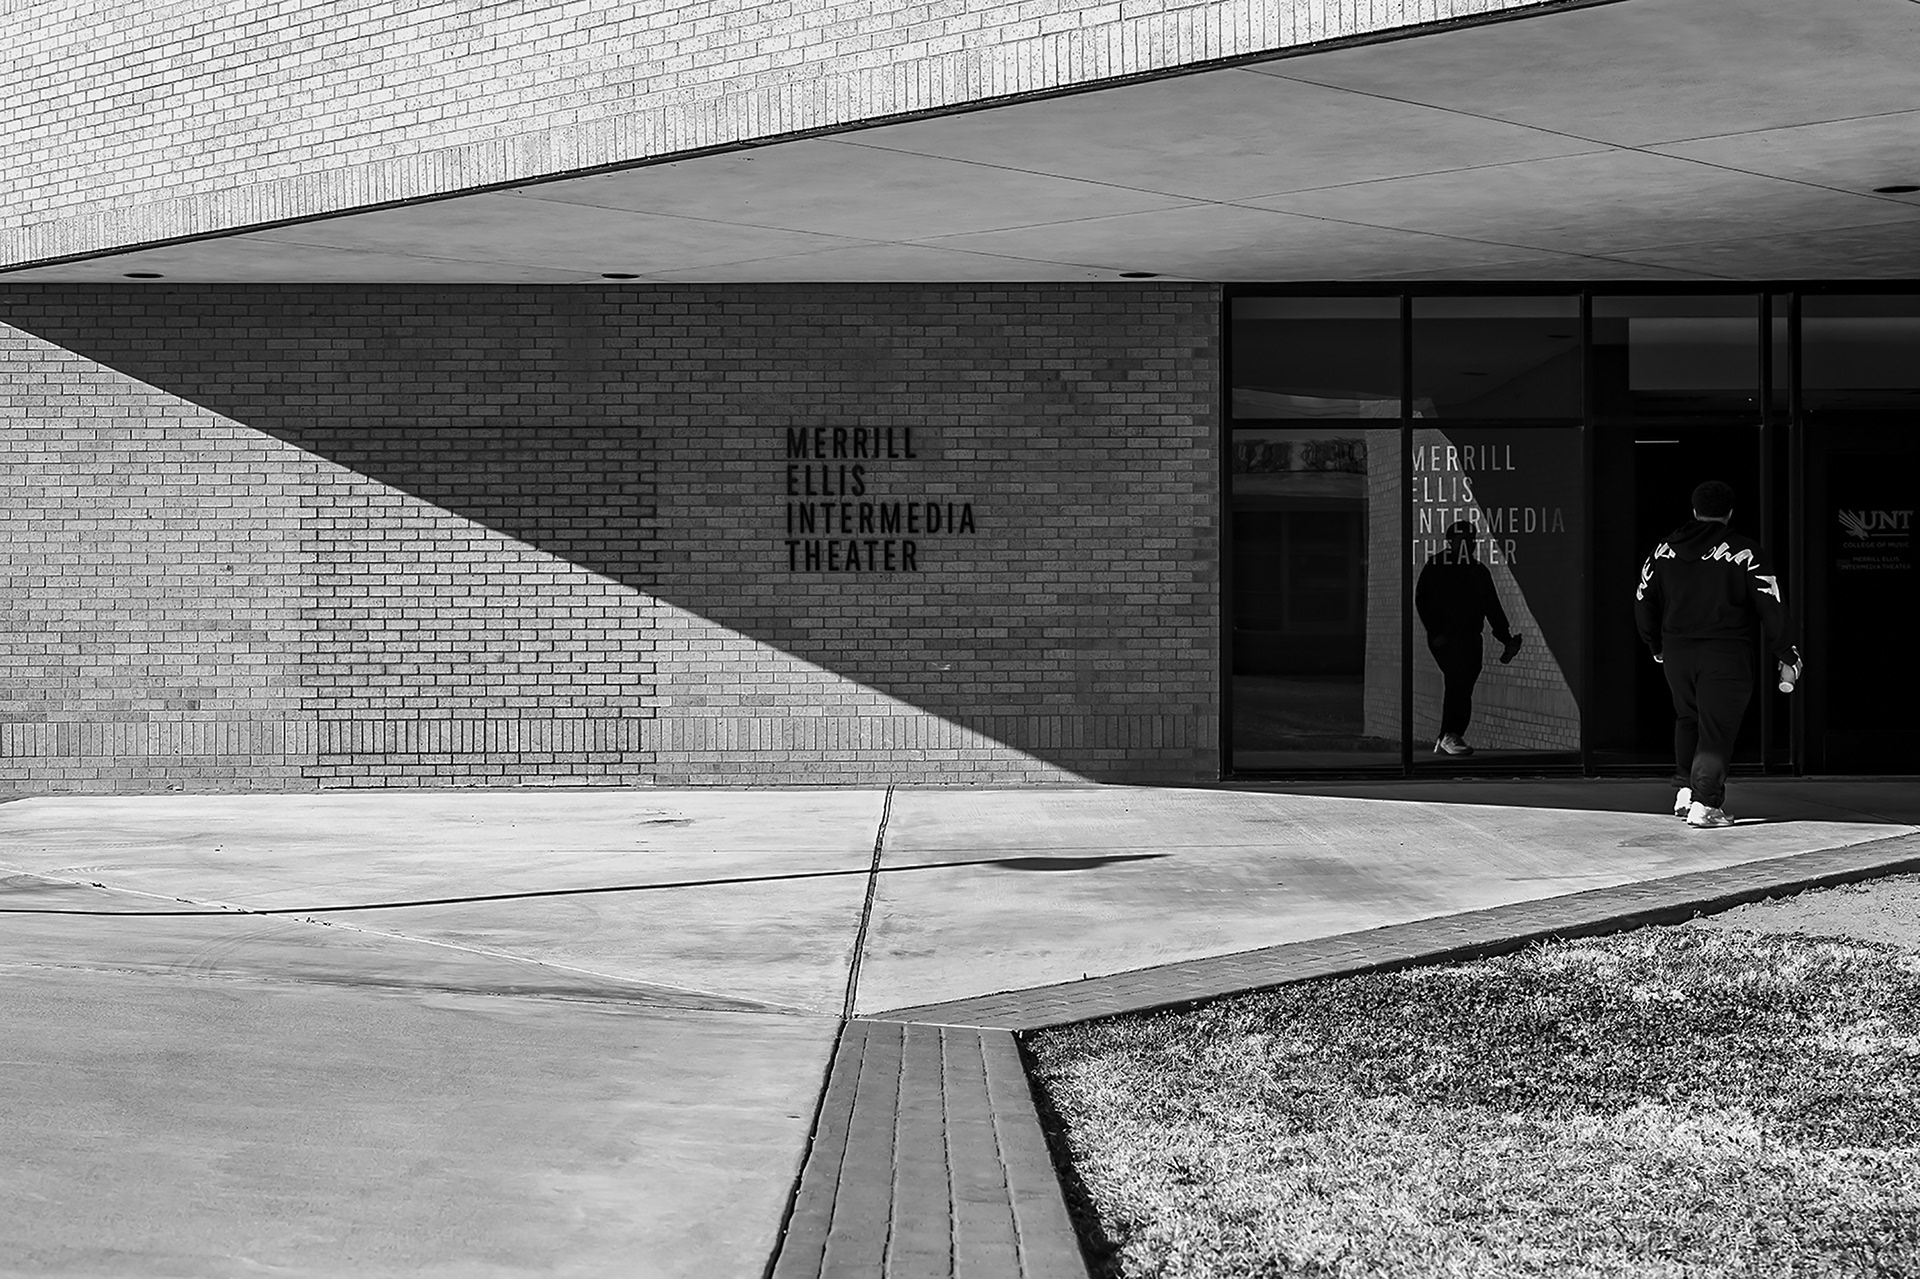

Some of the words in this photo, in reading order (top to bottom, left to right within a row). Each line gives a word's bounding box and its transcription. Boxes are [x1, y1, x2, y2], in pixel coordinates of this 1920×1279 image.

[786, 426, 917, 459] MERRILL
[1412, 445, 1516, 472] MERRILL
[786, 464, 866, 497] ELLIS
[1412, 476, 1474, 503] ELLIS
[786, 502, 976, 534] INTERMEDIA
[1419, 507, 1565, 534] NTERMEDIA
[1858, 510, 1914, 530] UNT
[784, 539, 918, 572] THEATER
[1412, 538, 1518, 566] THEATER
